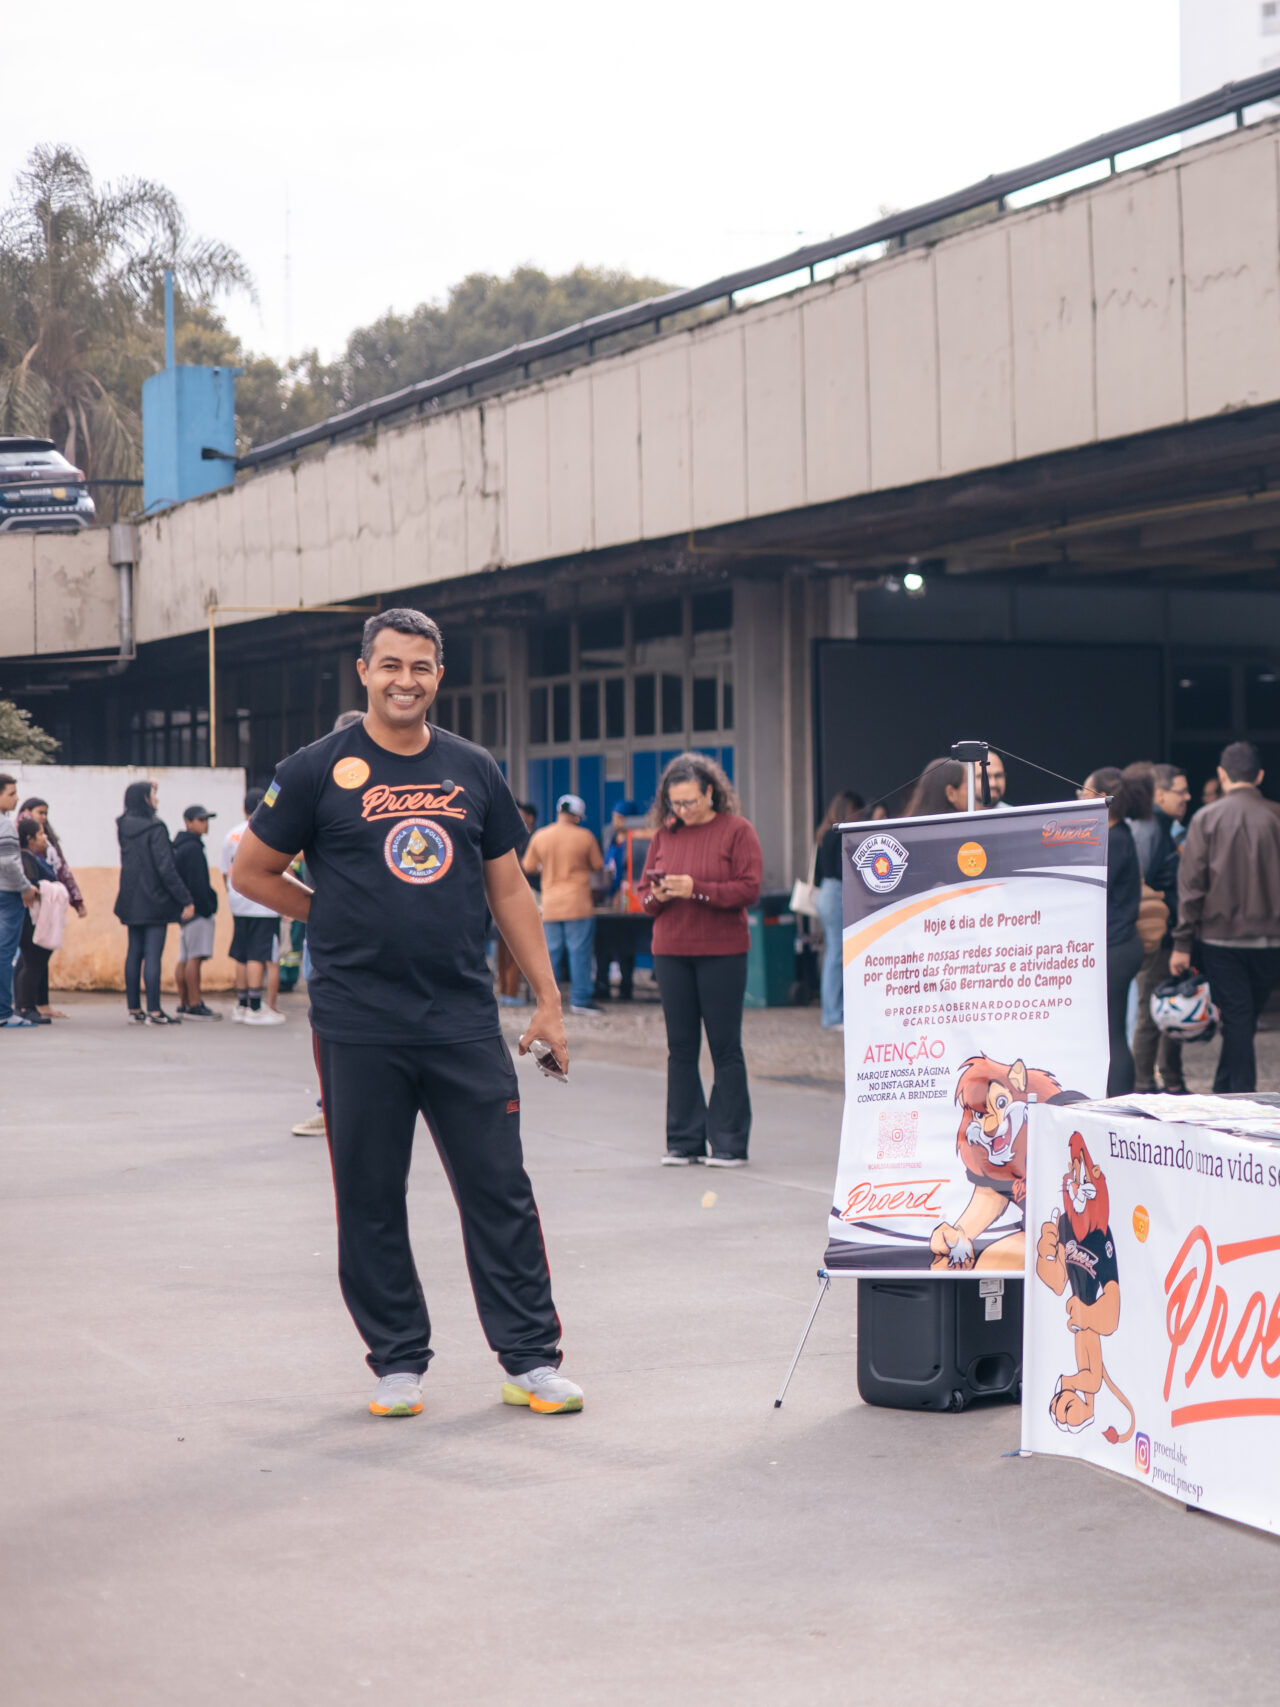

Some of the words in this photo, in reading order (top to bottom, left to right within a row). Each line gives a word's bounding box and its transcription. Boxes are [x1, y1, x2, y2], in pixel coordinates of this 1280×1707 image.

[361, 784, 467, 820] Proerd
[392, 830, 407, 853] ESCOLA
[880, 837, 904, 858] MILITAR
[924, 918, 946, 936] Hoje
[950, 915, 956, 930] é
[959, 915, 976, 929] dia
[980, 913, 993, 928] de
[998, 910, 1041, 927] Proerd!
[865, 951, 924, 968] Acompanhe
[927, 949, 960, 962] nossas
[963, 945, 992, 960] redes
[995, 944, 1033, 957] sociais
[1036, 943, 1063, 959] para
[1066, 940, 1094, 953] ficar
[864, 972, 883, 986] por
[886, 968, 920, 981] dentro
[922, 965, 940, 977] das
[943, 961, 1006, 976] formaturas
[1009, 961, 1016, 972] e
[1019, 956, 1079, 972] atividades
[1082, 954, 1096, 968] do
[885, 981, 920, 996] Proerd
[923, 982, 937, 992] em
[939, 979, 957, 992] São
[960, 975, 1013, 990] Bernardo
[1017, 974, 1031, 987] do
[1034, 974, 1072, 990] Campo
[885, 998, 1072, 1016] @PROERDSAOBERNARDODOCAMPO
[903, 1011, 1050, 1027] @CARLOSAUGUSTOPROERD
[863, 1036, 945, 1065] ATENÇÃO
[857, 1070, 889, 1081] MARQUE
[890, 1068, 916, 1078] NOSSA
[917, 1065, 950, 1076] PÁGINA
[869, 1082, 880, 1091] NO
[881, 1079, 929, 1090] INSTAGRAM
[930, 1079, 936, 1087] E
[857, 1092, 897, 1103] CONCORRA
[899, 1091, 906, 1100] A
[1108, 1131, 1194, 1170] Ensinando
[1195, 1152, 1223, 1178] uma
[1227, 1152, 1264, 1185] vida
[842, 1179, 951, 1218] Proerd
[1153, 1441, 1187, 1466] proerd.sbc
[1152, 1467, 1203, 1502] proerd.pmesp
